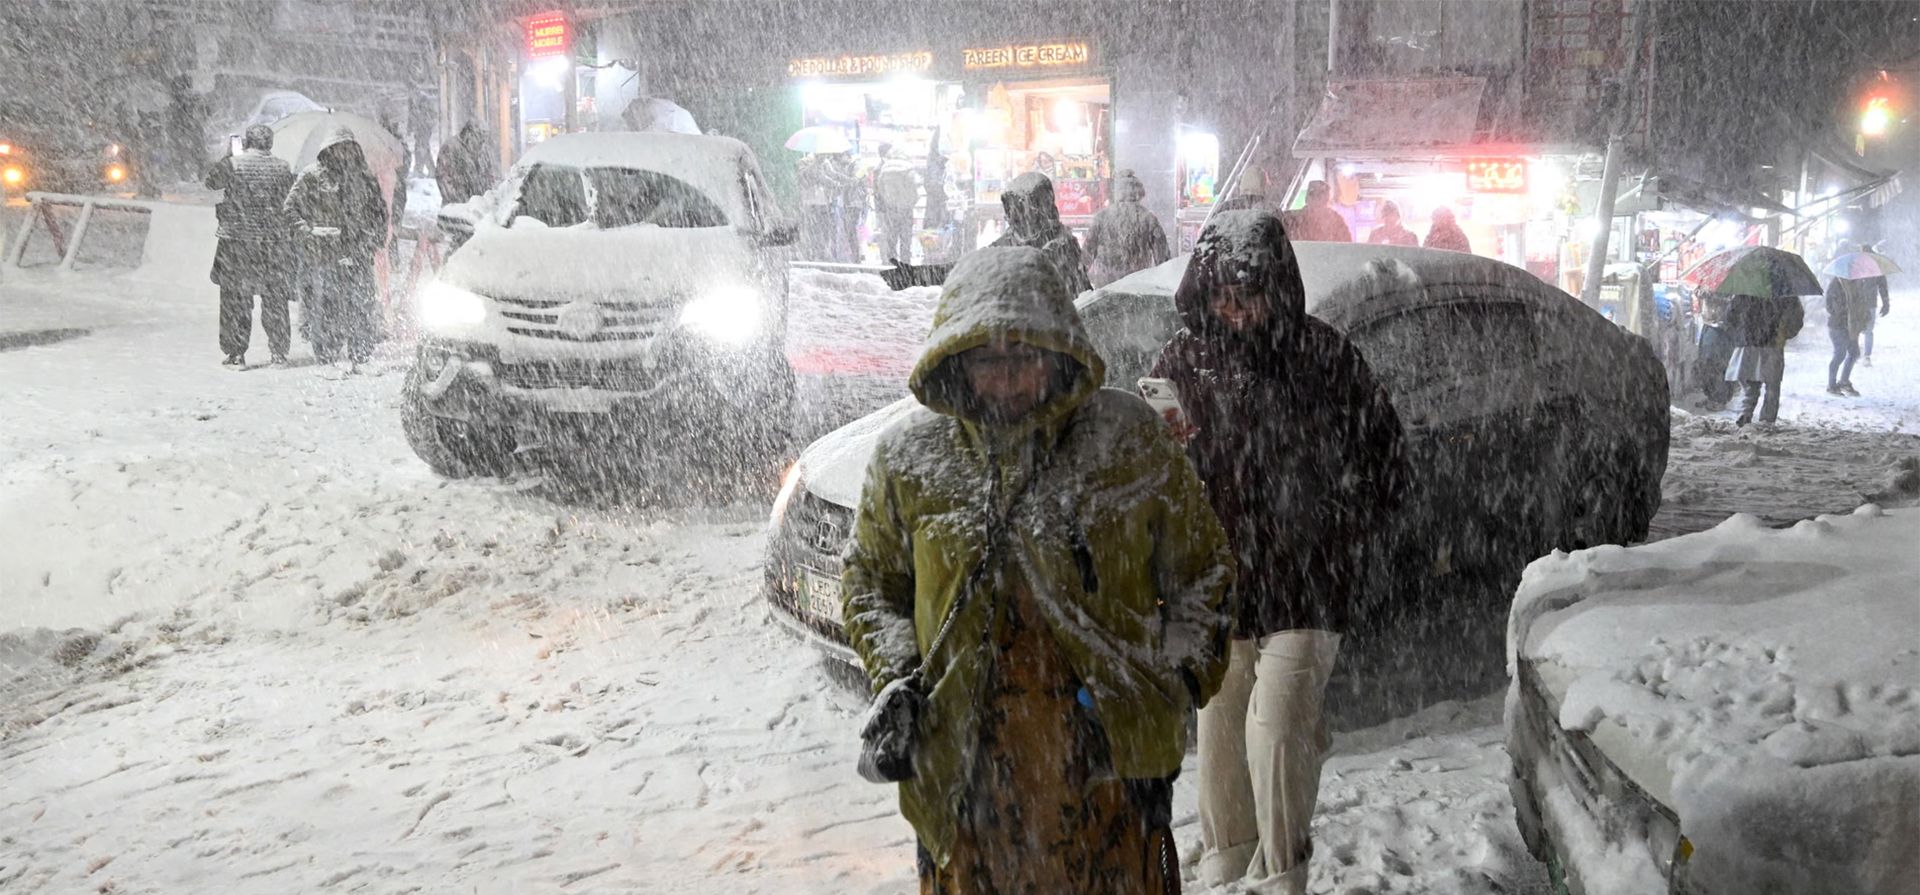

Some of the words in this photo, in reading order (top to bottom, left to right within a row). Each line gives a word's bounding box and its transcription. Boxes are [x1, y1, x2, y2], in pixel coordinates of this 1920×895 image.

[534, 36, 563, 48] MOBILE
[810, 58, 848, 74] DOLLAR
[850, 58, 858, 72] &
[860, 56, 897, 73] POUND
[899, 54, 928, 72] SHOP
[962, 48, 1009, 65] TAREEN
[1013, 47, 1034, 63] ICE
[1039, 45, 1086, 62] CREAM
